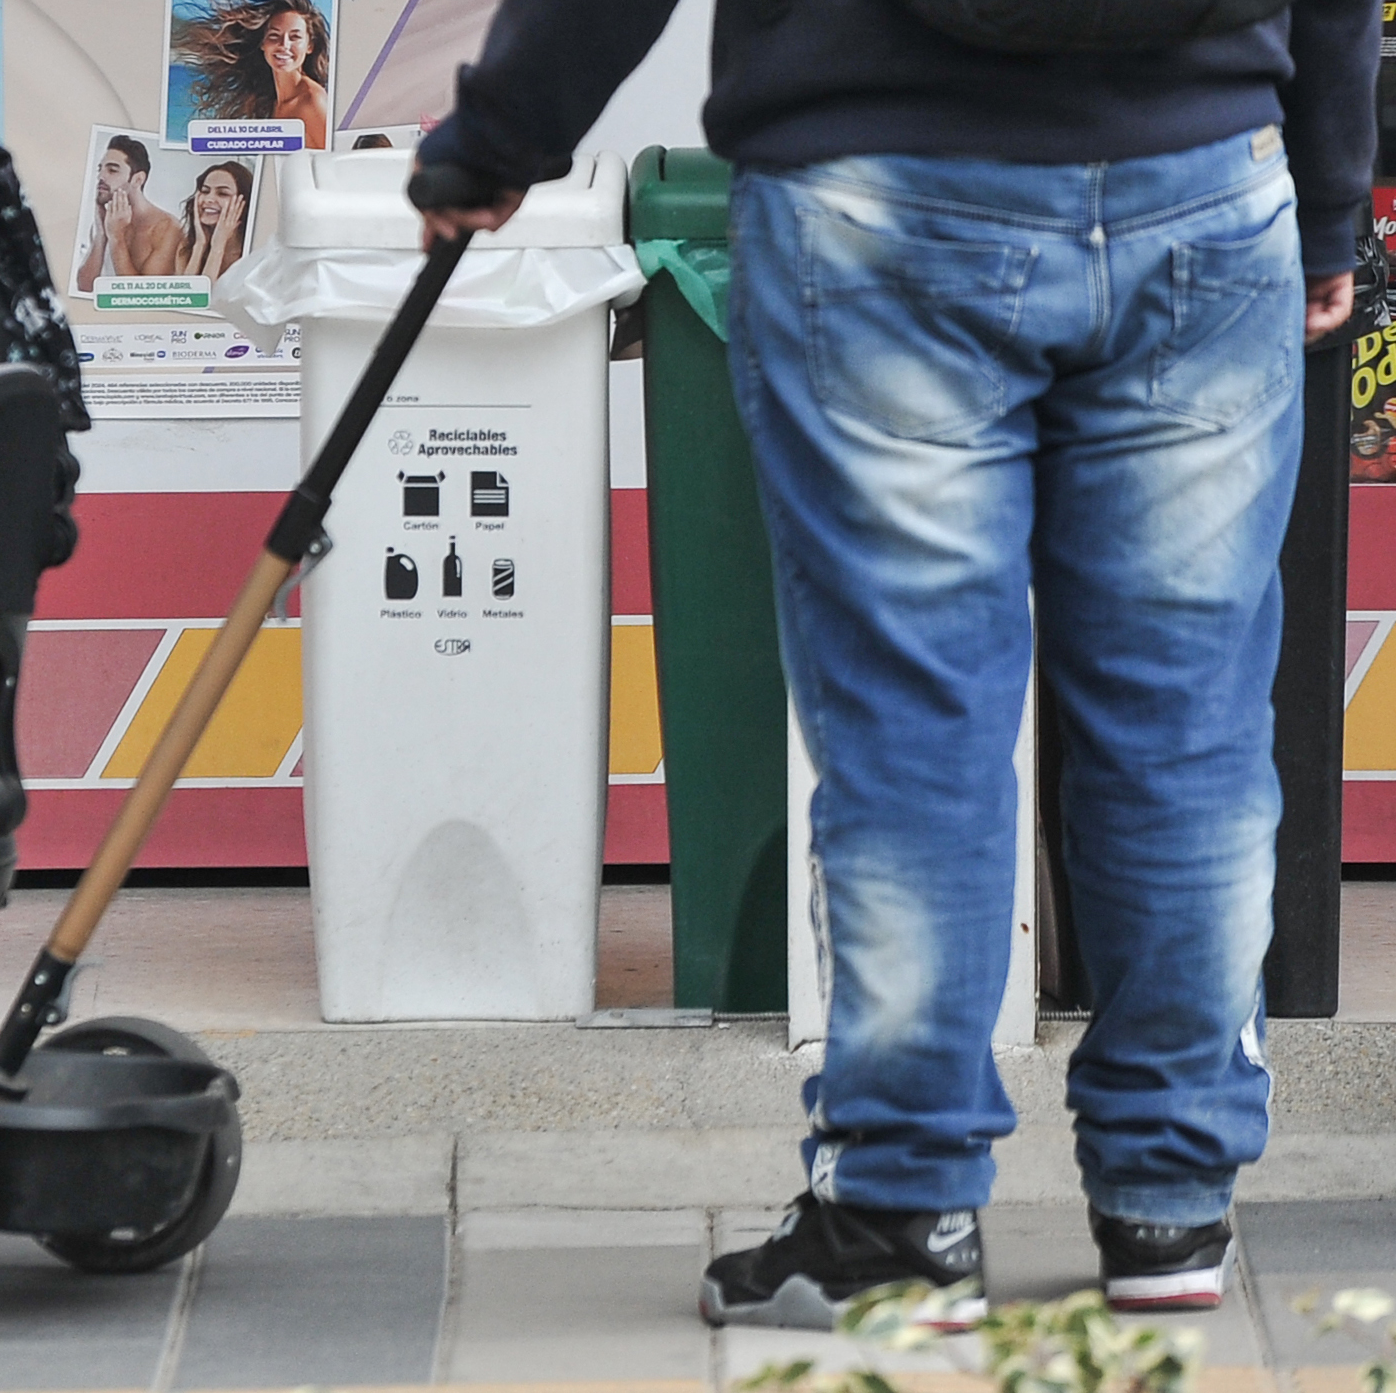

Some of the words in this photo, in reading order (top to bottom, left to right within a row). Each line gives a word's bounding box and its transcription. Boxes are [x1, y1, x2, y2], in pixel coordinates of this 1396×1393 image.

[207, 141, 246, 149] CUIDADO
[247, 140, 284, 149] CAPILAR
[110, 295, 192, 306] DERMOCOSMÉTICA
[429, 429, 507, 442] Reciclables
[417, 444, 518, 457] Aprovechables
[403, 522, 439, 530] Cartón
[475, 522, 504, 531] Papel
[380, 609, 421, 619] Plástico
[437, 610, 467, 619] Vidrio
[482, 610, 524, 619] Metales
